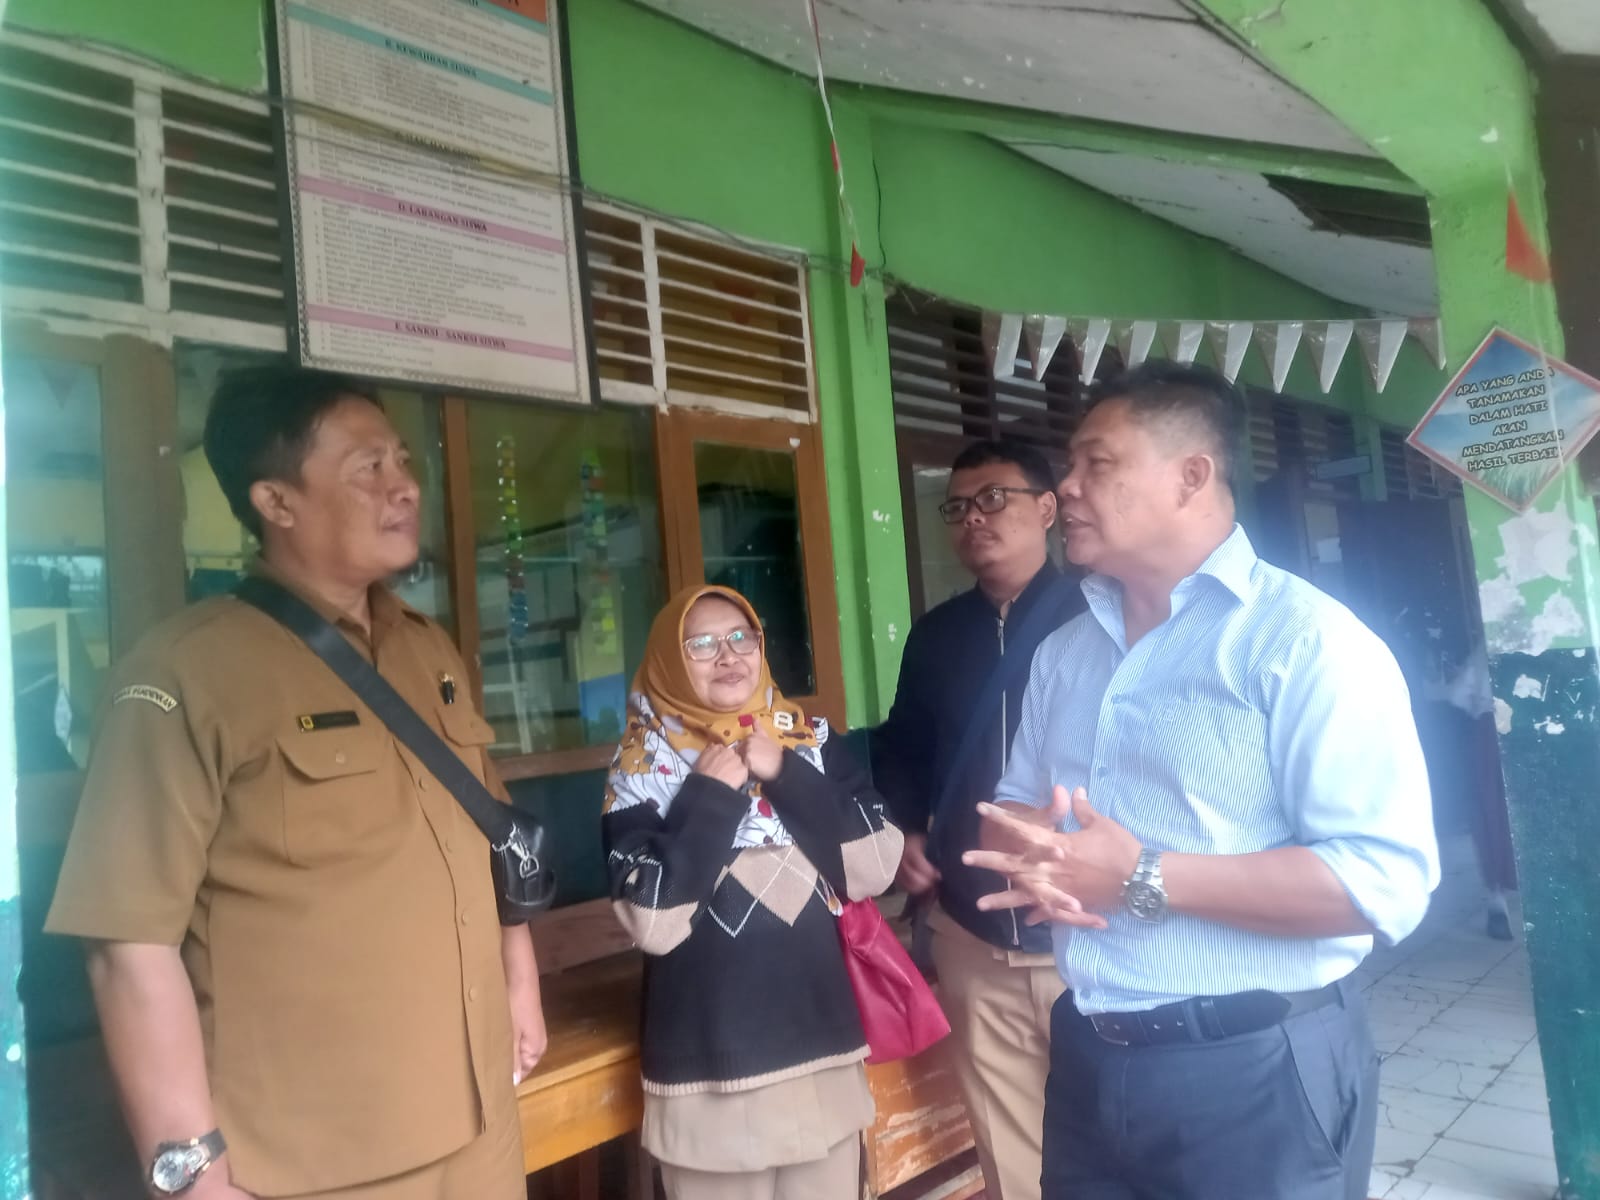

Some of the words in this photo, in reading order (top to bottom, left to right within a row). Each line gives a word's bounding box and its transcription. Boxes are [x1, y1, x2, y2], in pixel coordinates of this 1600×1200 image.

[409, 204, 459, 226] LARANGAN
[461, 217, 488, 233] SISWA
[1456, 383, 1478, 397] APA
[1482, 376, 1515, 390] YANG
[1467, 385, 1545, 409] TANAMAKAN
[1469, 409, 1512, 425] DALAM
[1514, 401, 1549, 417] HATI
[1493, 420, 1527, 436] AKAN
[1462, 430, 1564, 457] MENDATANGKAN
[1468, 458, 1506, 472] HASIL
